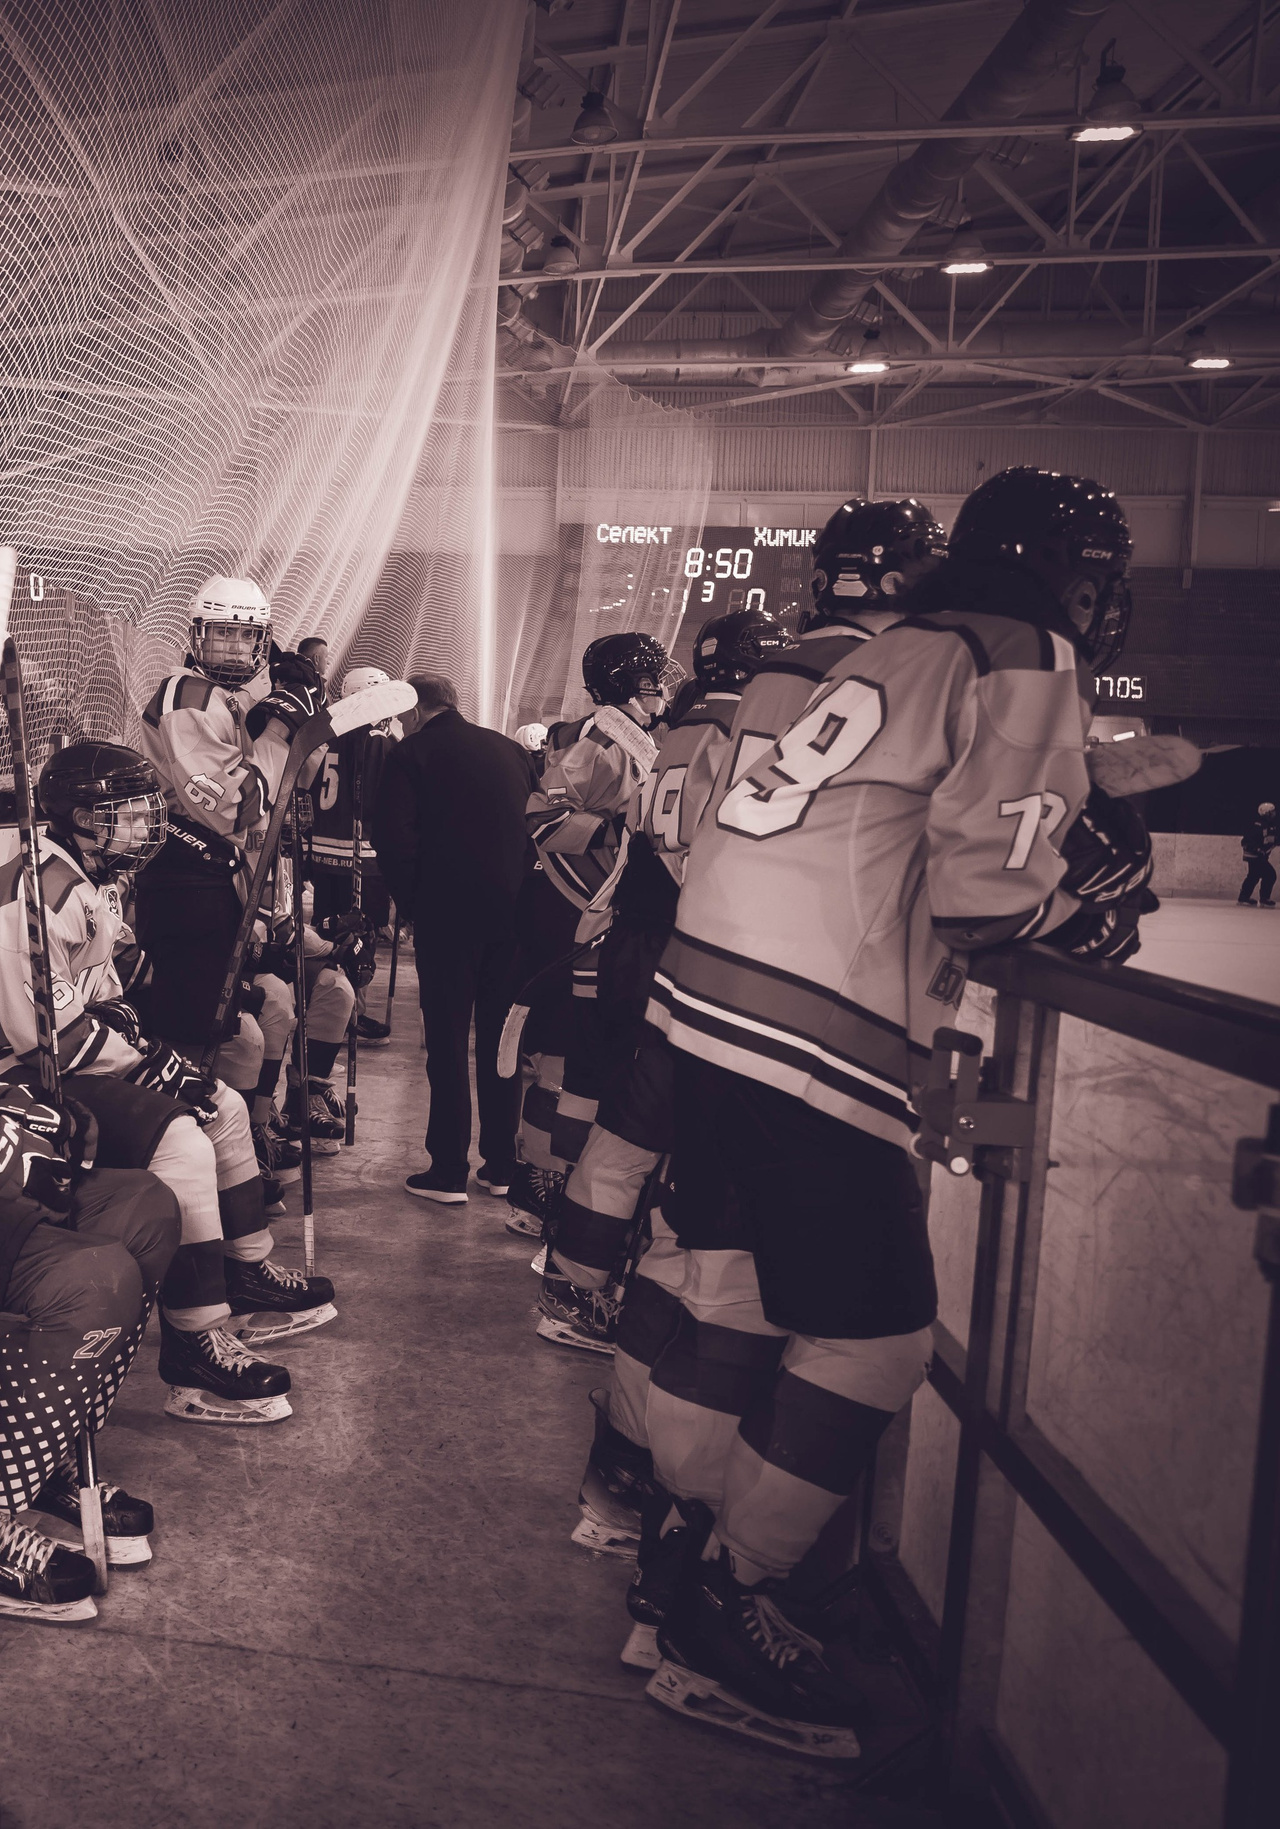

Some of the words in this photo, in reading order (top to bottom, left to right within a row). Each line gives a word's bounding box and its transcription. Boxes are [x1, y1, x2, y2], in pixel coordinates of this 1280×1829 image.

[1081, 548, 1112, 560] CCM
[684, 547, 754, 579] 8:50
[701, 581, 715, 602] 3
[231, 604, 257, 612] BAUER
[29, 1123, 58, 1133] CCM
[73, 1327, 121, 1359] 27
